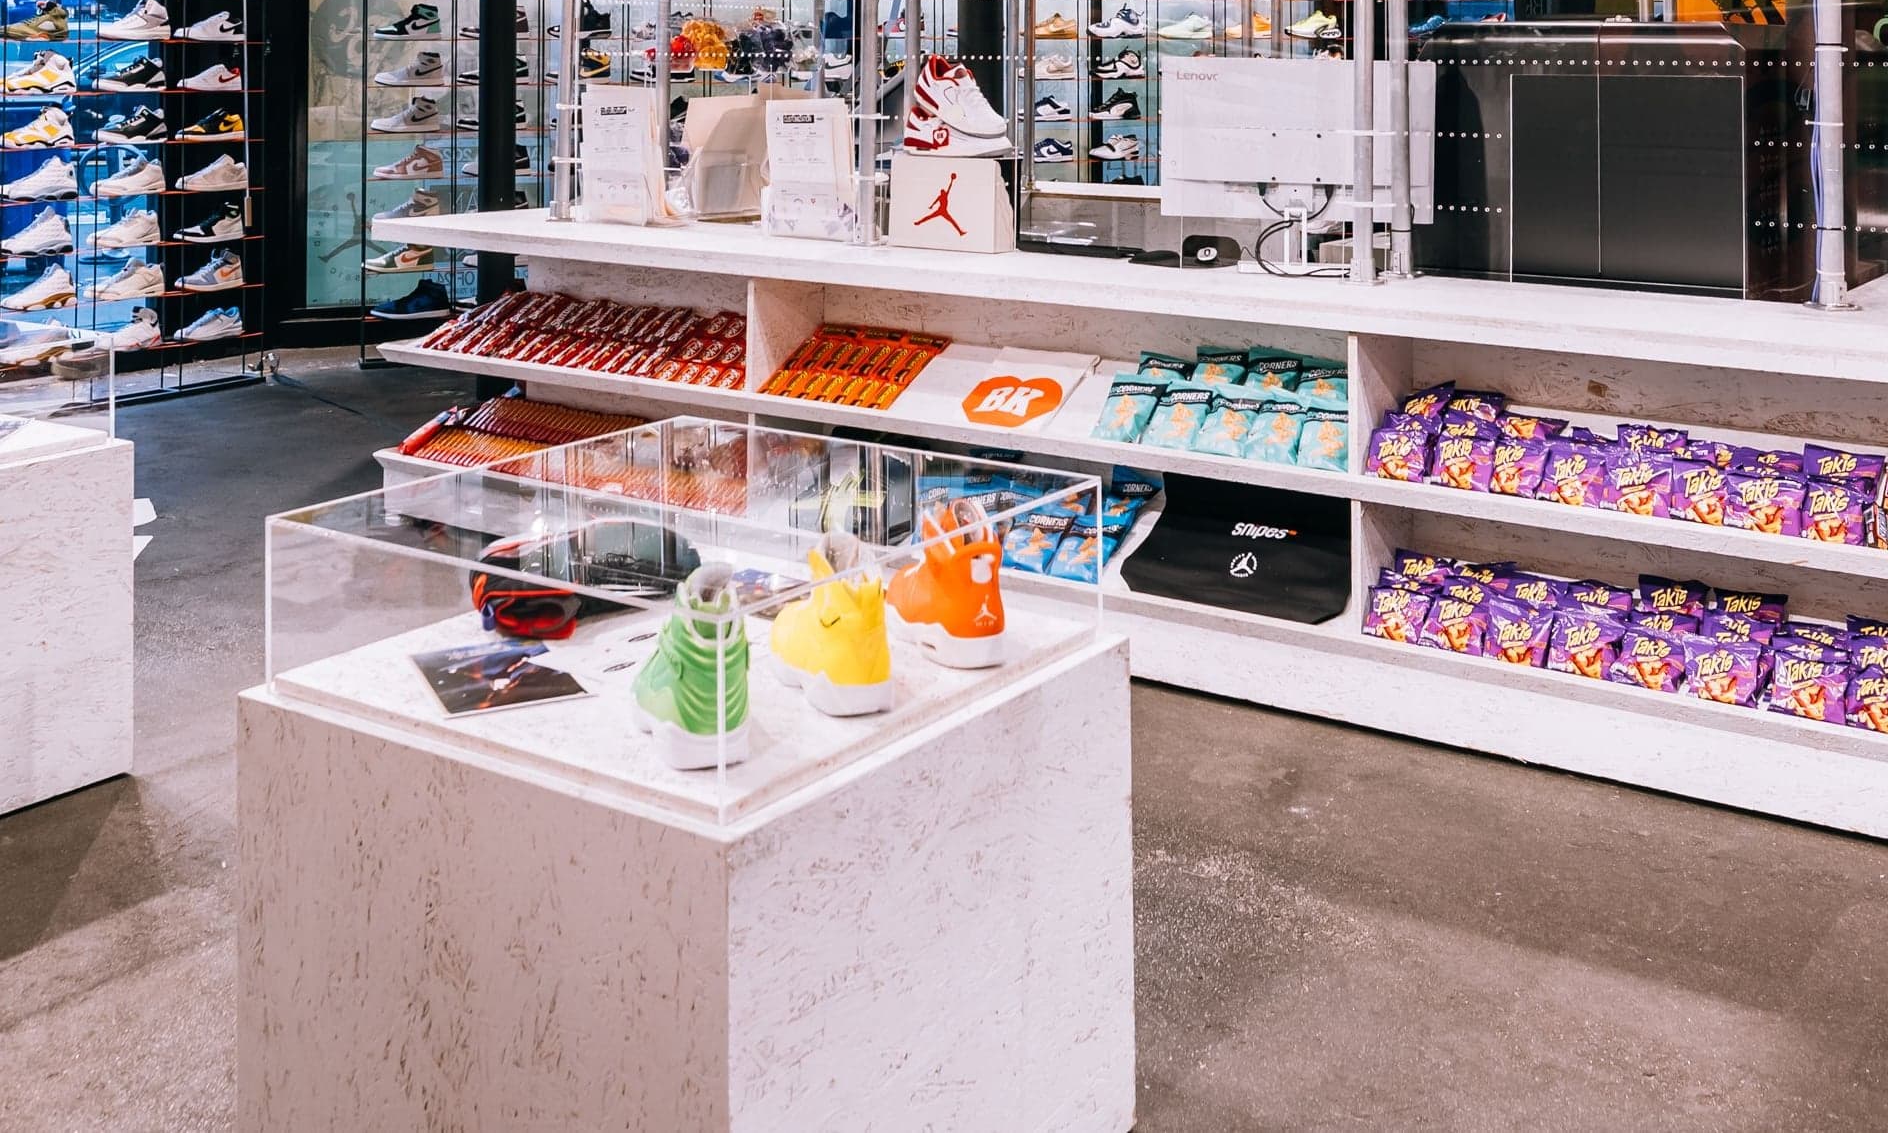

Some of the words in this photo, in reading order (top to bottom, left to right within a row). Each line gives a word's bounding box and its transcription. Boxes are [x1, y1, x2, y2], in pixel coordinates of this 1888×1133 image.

[1258, 360, 1298, 372] CORNERS
[972, 385, 1045, 417] BK
[1170, 391, 1210, 403] CORNERS
[1378, 436, 1414, 460] Takis
[1439, 438, 1474, 464] Takis
[1494, 443, 1528, 465] Takis
[1552, 456, 1588, 483] Takis
[1817, 454, 1858, 476] Takis
[1615, 466, 1654, 491] Takis
[1682, 469, 1725, 498] Takis
[1738, 478, 1780, 505] Takis
[1808, 488, 1851, 517] Takis
[1029, 514, 1069, 528] CORNERS
[1515, 581, 1549, 603] Takis
[1651, 587, 1689, 609] Takis
[1722, 594, 1762, 614] Takis
[1438, 598, 1476, 624] Takis
[1497, 619, 1535, 645] Takis
[1564, 622, 1602, 650] Takis
[1695, 651, 1735, 678] Takis
[1783, 658, 1825, 684] Takis
